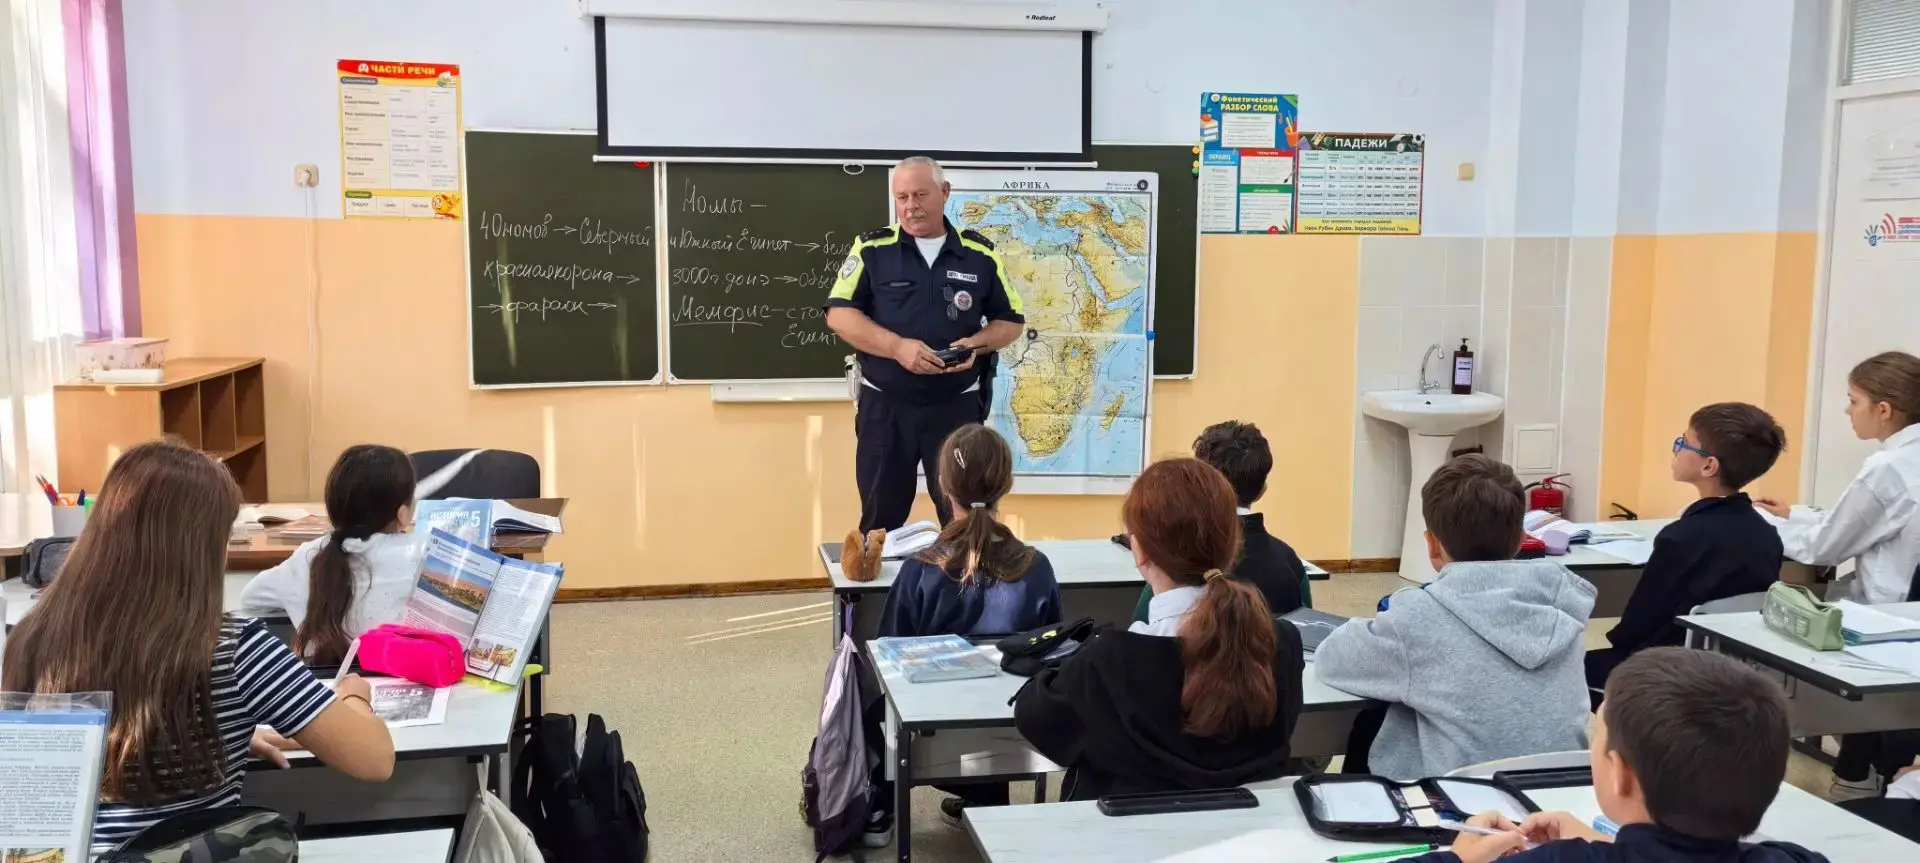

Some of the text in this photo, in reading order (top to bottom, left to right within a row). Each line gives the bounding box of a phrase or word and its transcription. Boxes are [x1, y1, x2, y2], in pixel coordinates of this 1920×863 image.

[371, 64, 436, 75] ЧАСТИ РЕЧИ
[1220, 103, 1279, 112] РАЗБОР СЛОВА
[1334, 137, 1388, 149] ПАДЕЖИ
[1002, 181, 1050, 190] АФРИКА
[682, 177, 743, 214] Номы
[736, 228, 794, 251] Египет
[470, 510, 480, 528] 5
